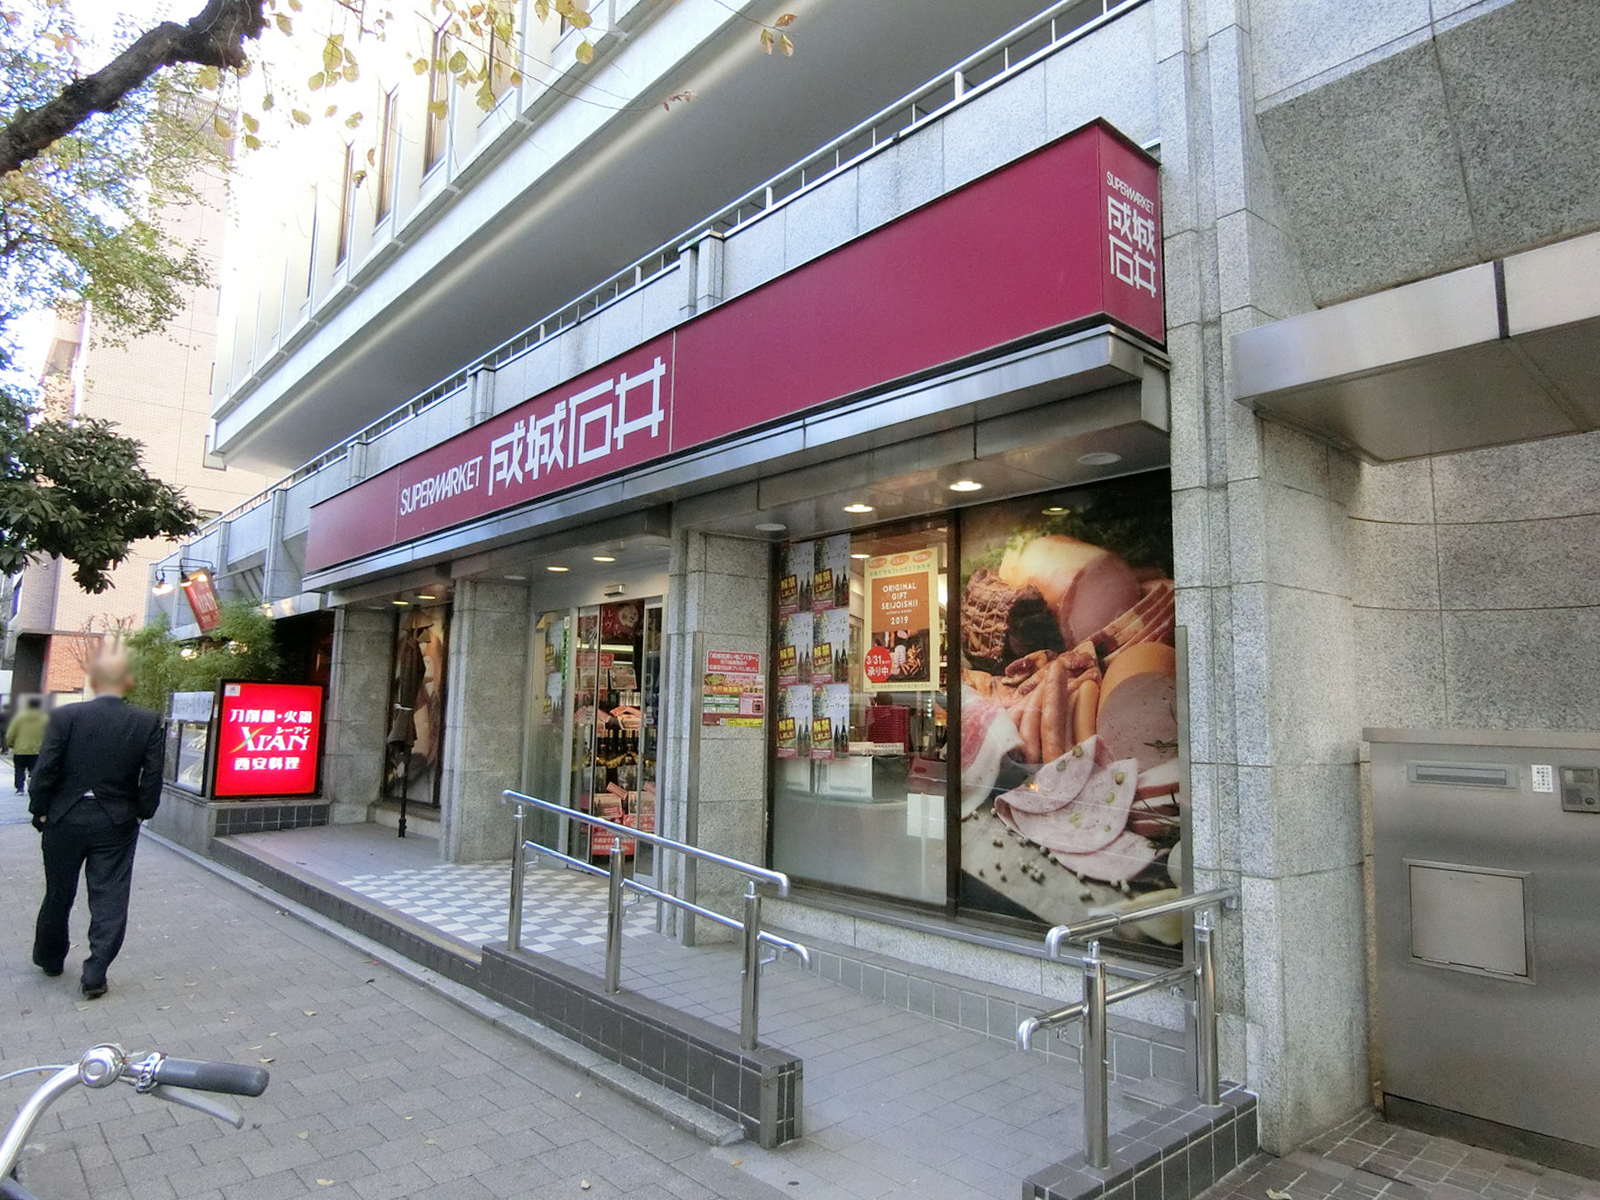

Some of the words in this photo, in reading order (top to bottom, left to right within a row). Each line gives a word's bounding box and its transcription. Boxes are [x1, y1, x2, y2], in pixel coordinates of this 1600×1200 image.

[1106, 171, 1155, 215] SUPERMARKET
[1107, 195, 1157, 258] 成城
[1108, 233, 1157, 299] 石井
[400, 455, 483, 516] SUPERMARKET
[488, 356, 666, 496] 成城石井
[882, 582, 917, 593] ORIGINAL
[891, 592, 907, 600] GIFT
[881, 599, 918, 610] SEIJOISHII
[890, 616, 909, 625] 2019
[867, 666, 889, 676] 承り中
[275, 726, 311, 735] シーアン
[233, 757, 300, 771] 西安料理
